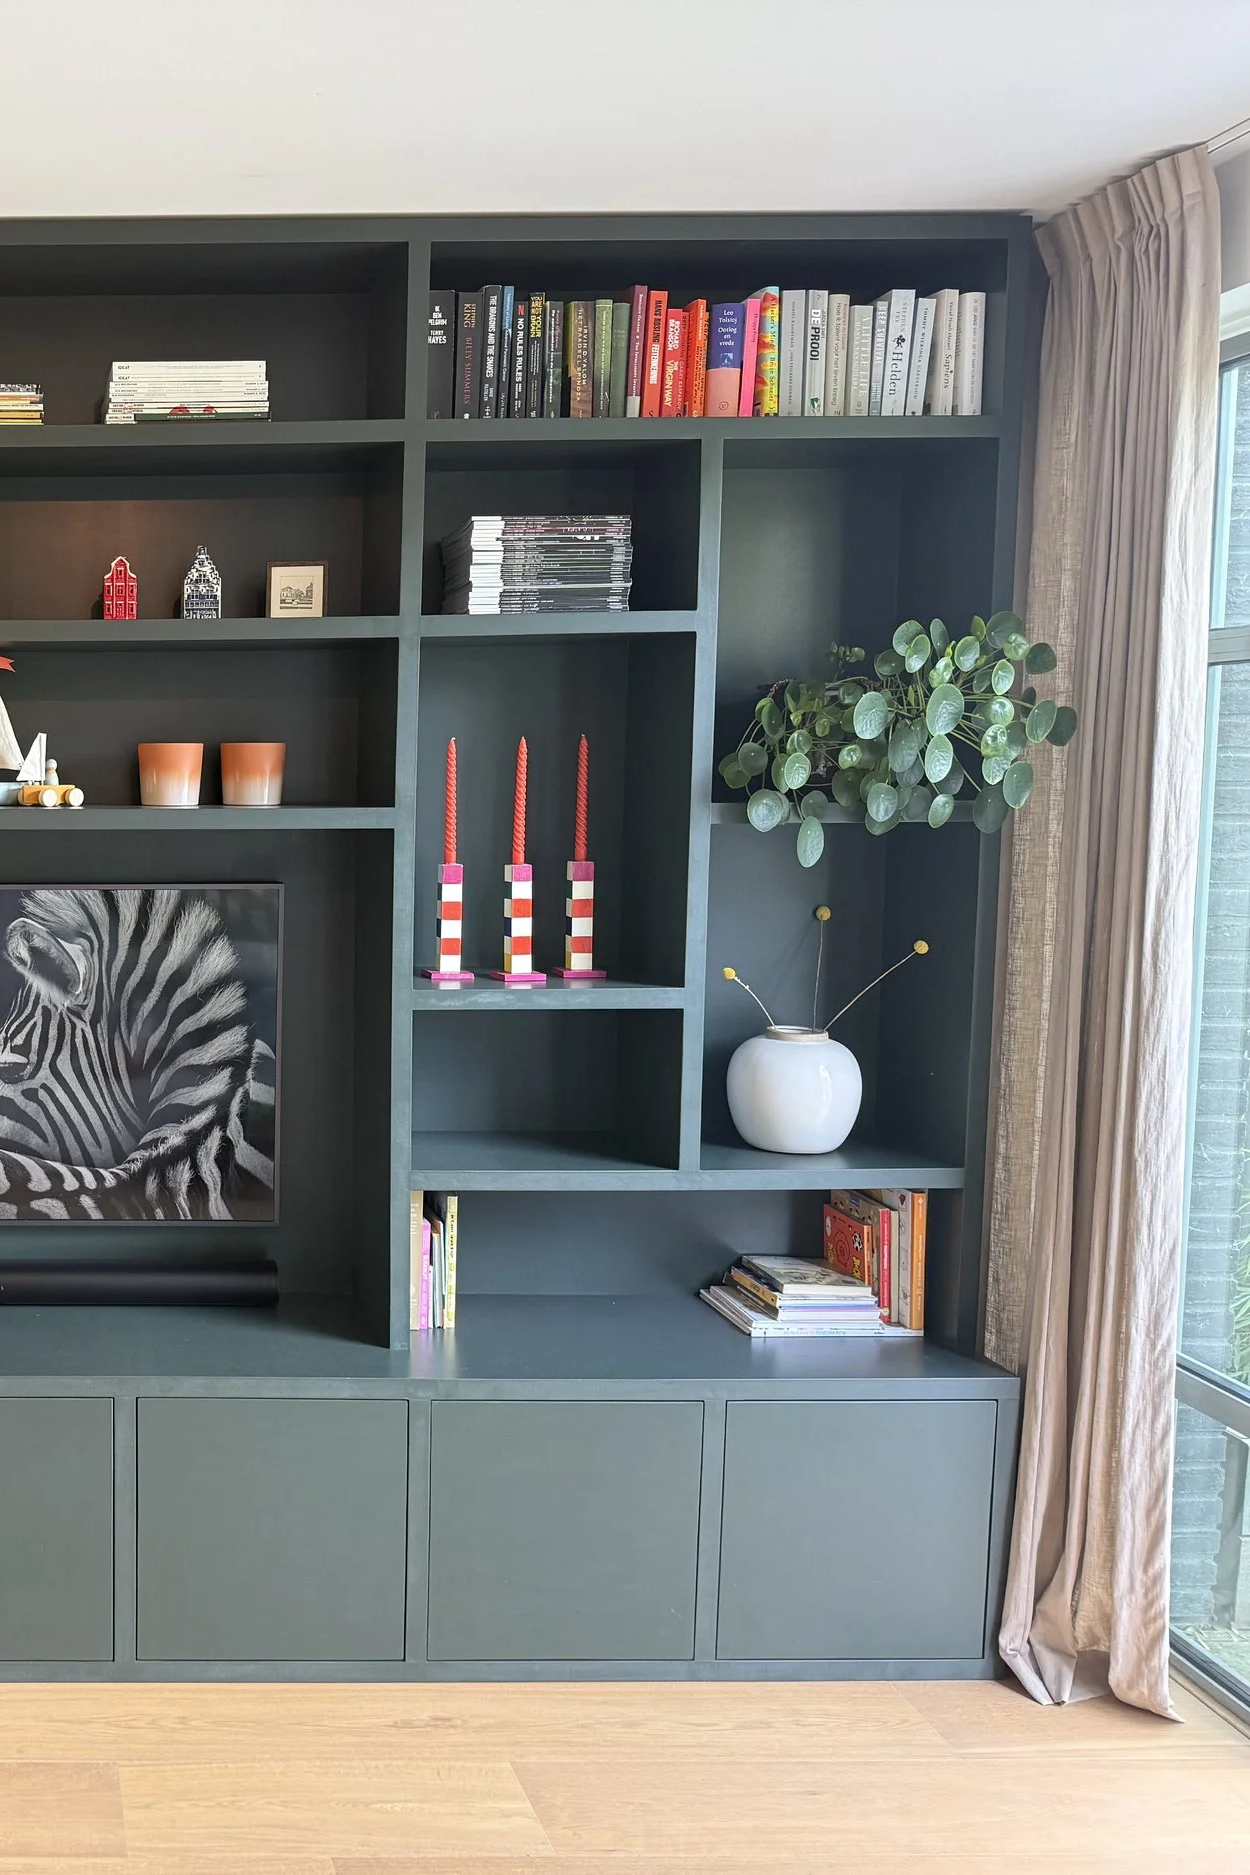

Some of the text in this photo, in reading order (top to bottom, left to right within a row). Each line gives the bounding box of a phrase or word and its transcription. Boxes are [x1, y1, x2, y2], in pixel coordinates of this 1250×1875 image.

[463, 303, 471, 328] KING
[517, 318, 524, 329] NO
[717, 326, 737, 334] Oorlog
[900, 302, 908, 333] STEPHEN
[921, 307, 929, 330] TOMMY
[427, 335, 447, 344] HAYES
[485, 295, 498, 378] THE DRAGONS AND THE SNAKES
[516, 331, 524, 356] RULES
[649, 300, 663, 385] HANS ROSLING FEITENKENNIS
[667, 319, 675, 351] BRANSON
[809, 309, 821, 361] DE PROOI
[860, 324, 870, 367] LITTLE
[874, 306, 887, 365] DEEP SURVIVAL
[918, 332, 926, 363] WIERINGA
[463, 337, 473, 405] BILLY SUMMERS
[515, 357, 523, 382] RULES
[663, 360, 674, 407] VIRGIN WAY
[859, 371, 869, 397] LIFE
[888, 352, 904, 396] Helden
[943, 353, 953, 389] Sapiens
